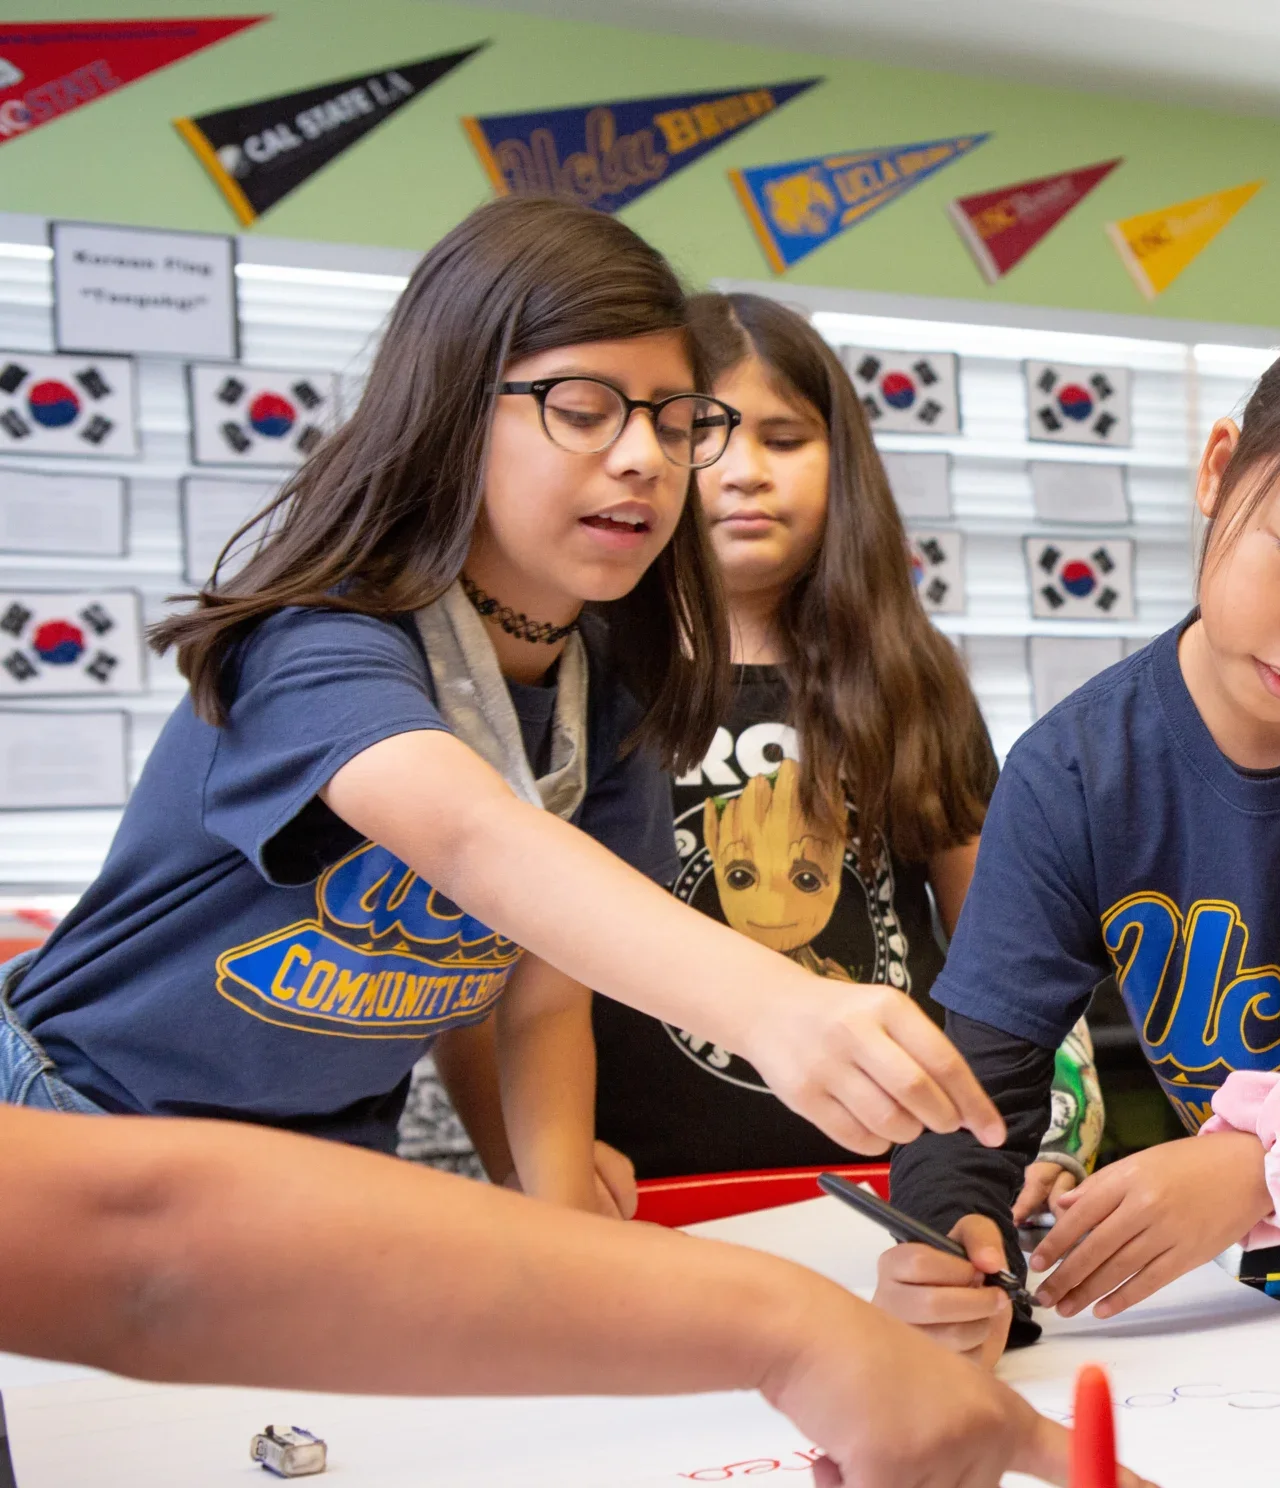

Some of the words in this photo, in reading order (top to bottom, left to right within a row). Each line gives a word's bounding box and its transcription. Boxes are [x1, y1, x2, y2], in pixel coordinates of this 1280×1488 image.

[243, 122, 302, 163] CAL
[295, 87, 376, 139] STATE
[367, 70, 415, 105] LA
[832, 160, 898, 204] UCLA
[73, 249, 156, 269] Korean
[163, 256, 214, 278] Flag
[269, 943, 461, 1019] COMMUNITY
